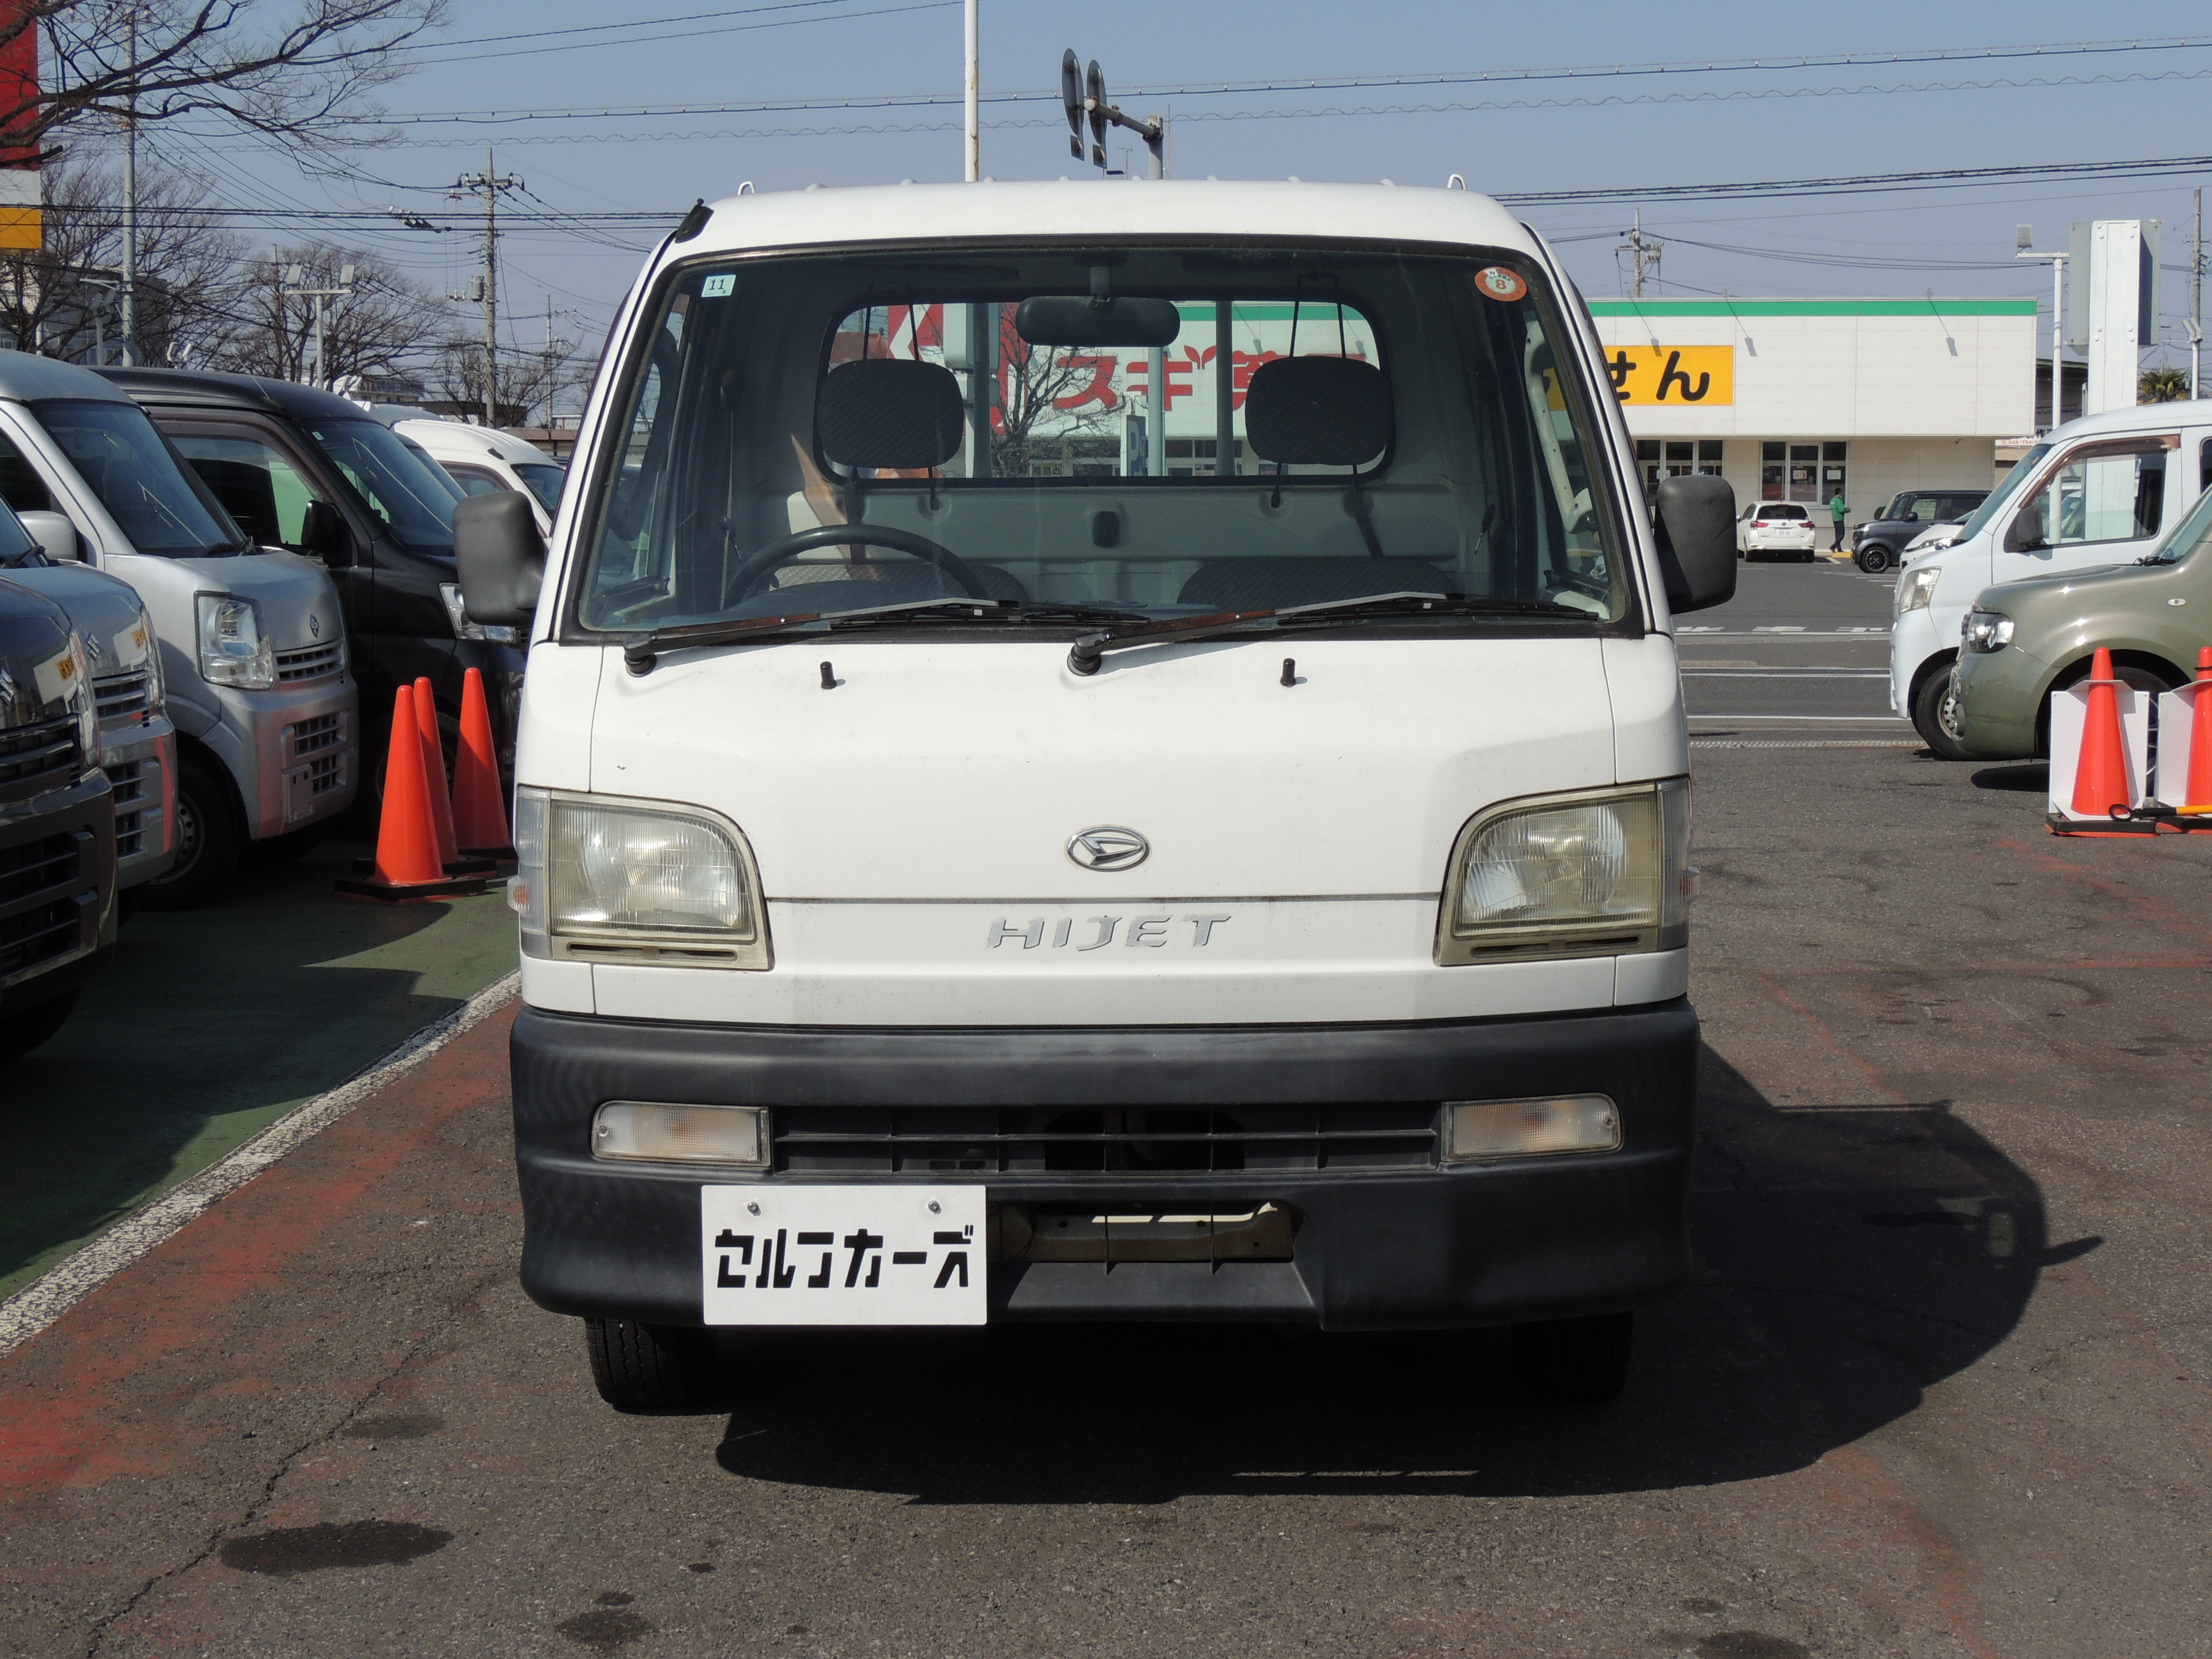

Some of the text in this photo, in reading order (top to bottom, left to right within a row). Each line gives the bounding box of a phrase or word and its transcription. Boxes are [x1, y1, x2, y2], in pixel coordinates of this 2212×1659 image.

[709, 278, 724, 290] 11
[1495, 279, 1507, 289] 8
[987, 914, 1231, 952] HIJET
